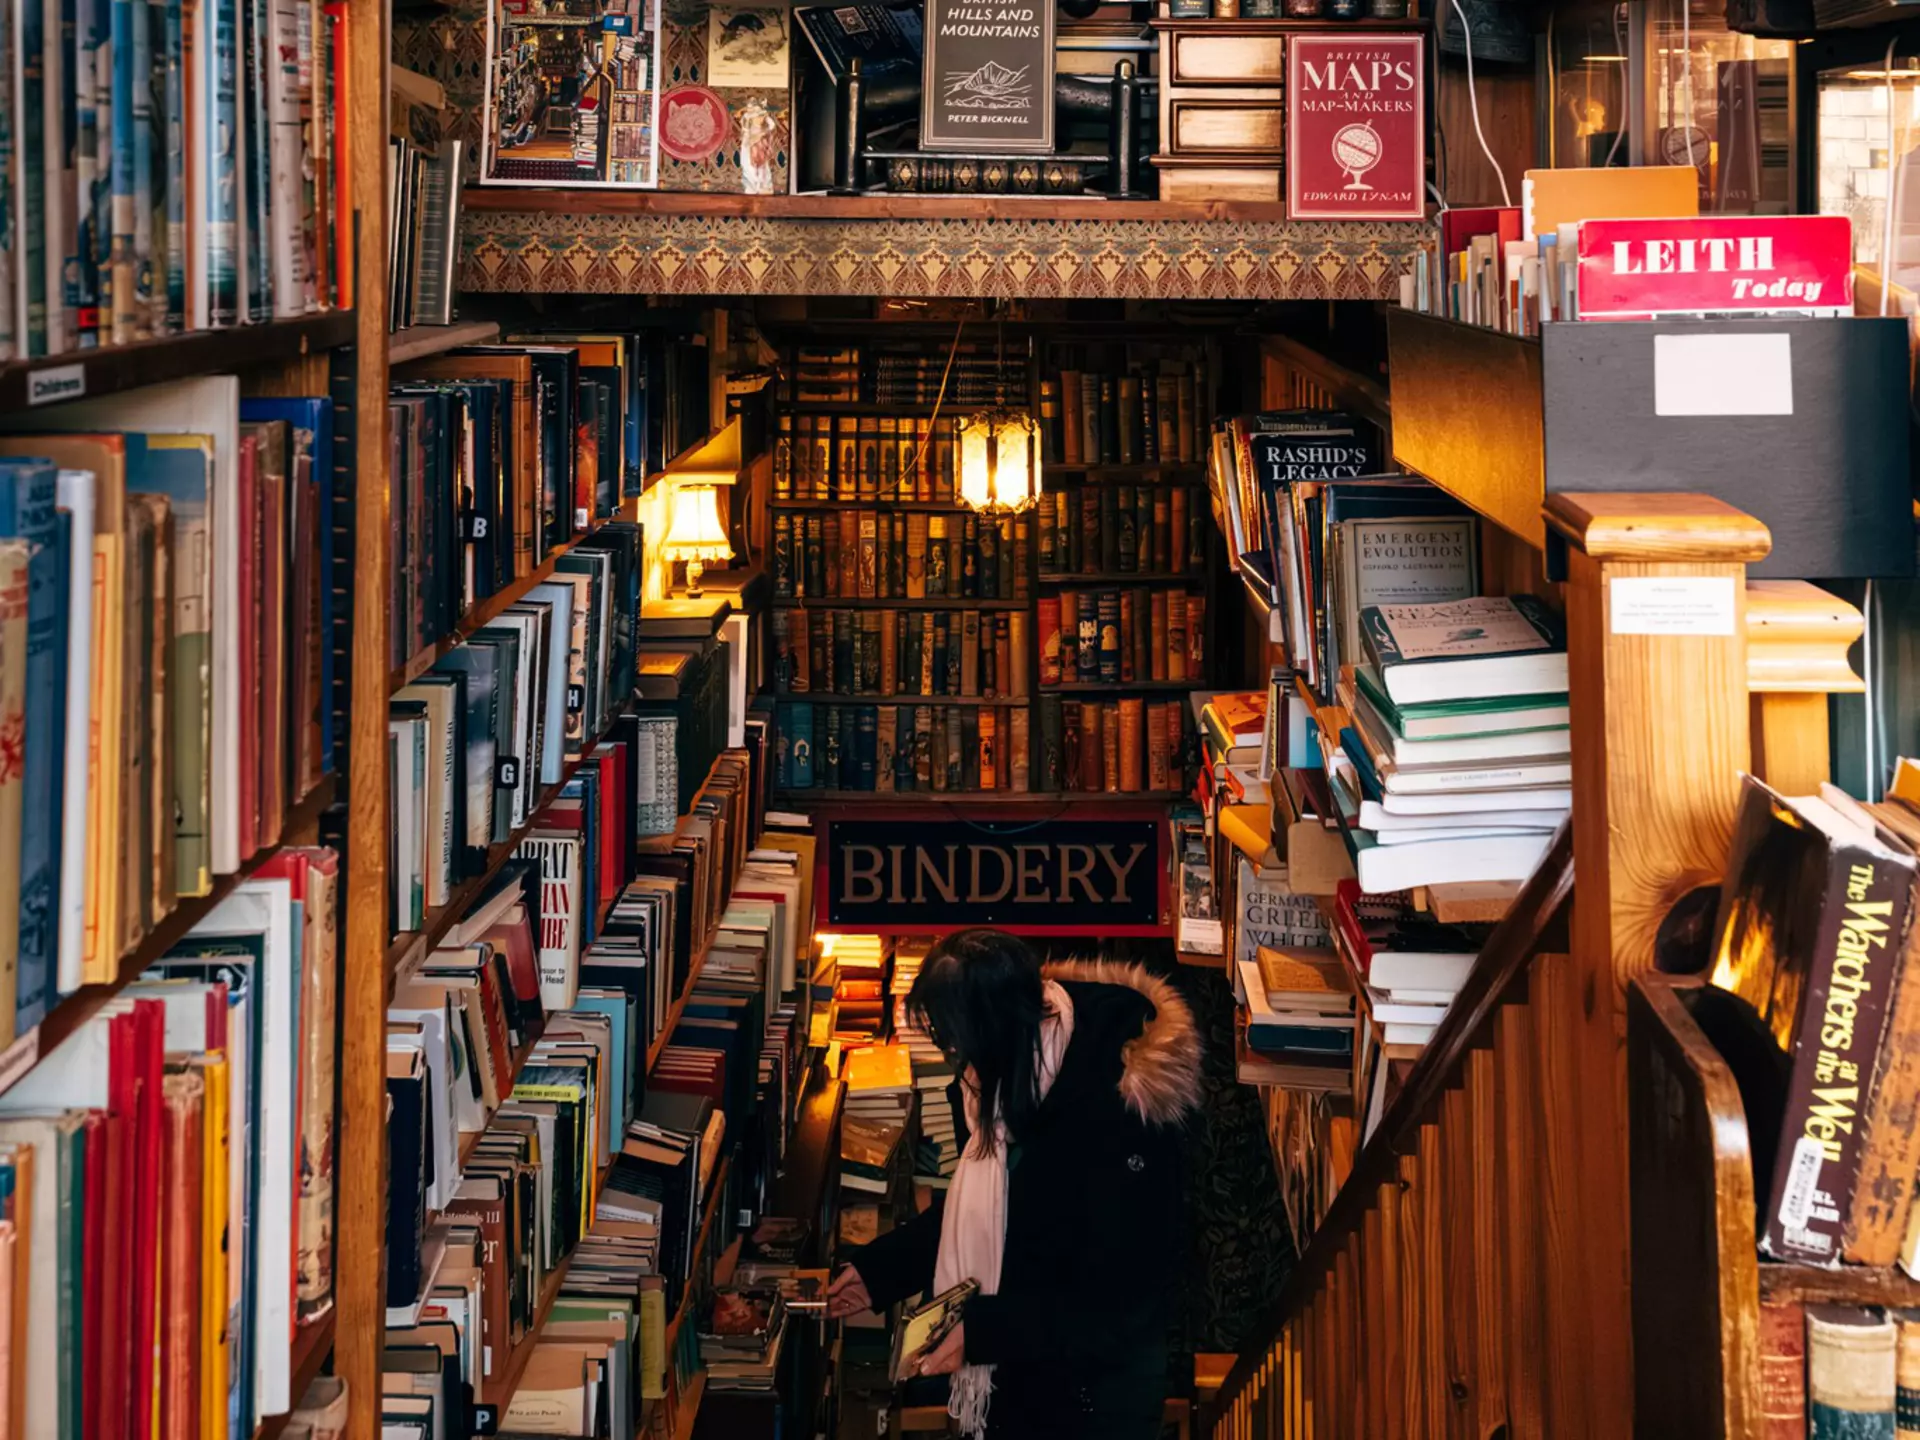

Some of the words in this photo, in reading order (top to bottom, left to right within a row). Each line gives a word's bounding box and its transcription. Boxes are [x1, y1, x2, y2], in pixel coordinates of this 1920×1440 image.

[947, 8, 993, 21] HILLS
[996, 9, 1034, 21] AND
[940, 24, 1040, 38] MOUNTAINS
[1326, 52, 1391, 61] BRITISH
[1302, 61, 1414, 91] MAPS
[1340, 92, 1374, 100] AND
[1302, 101, 1413, 112] MAP-MAKERS
[947, 114, 979, 123] PETER
[980, 115, 1029, 124] BICKNELL
[1303, 192, 1357, 201] EDWARD
[1361, 192, 1412, 201] LYNAM
[1611, 236, 1775, 275] LEITH
[1731, 277, 1823, 302] Today
[1266, 446, 1367, 464] RASHID'S
[1272, 464, 1362, 480] LEGACY
[472, 516, 488, 538] B
[1363, 532, 1463, 545] EMERGENT
[1363, 546, 1464, 559] EVOLUTION
[567, 689, 579, 708] H
[500, 762, 515, 785] G
[840, 843, 1147, 903] BINDERY
[1847, 864, 1875, 901] The
[545, 974, 566, 984] Head
[1820, 901, 1894, 1051] Watchers
[1814, 1050, 1841, 1084] the
[475, 1409, 490, 1430] P
